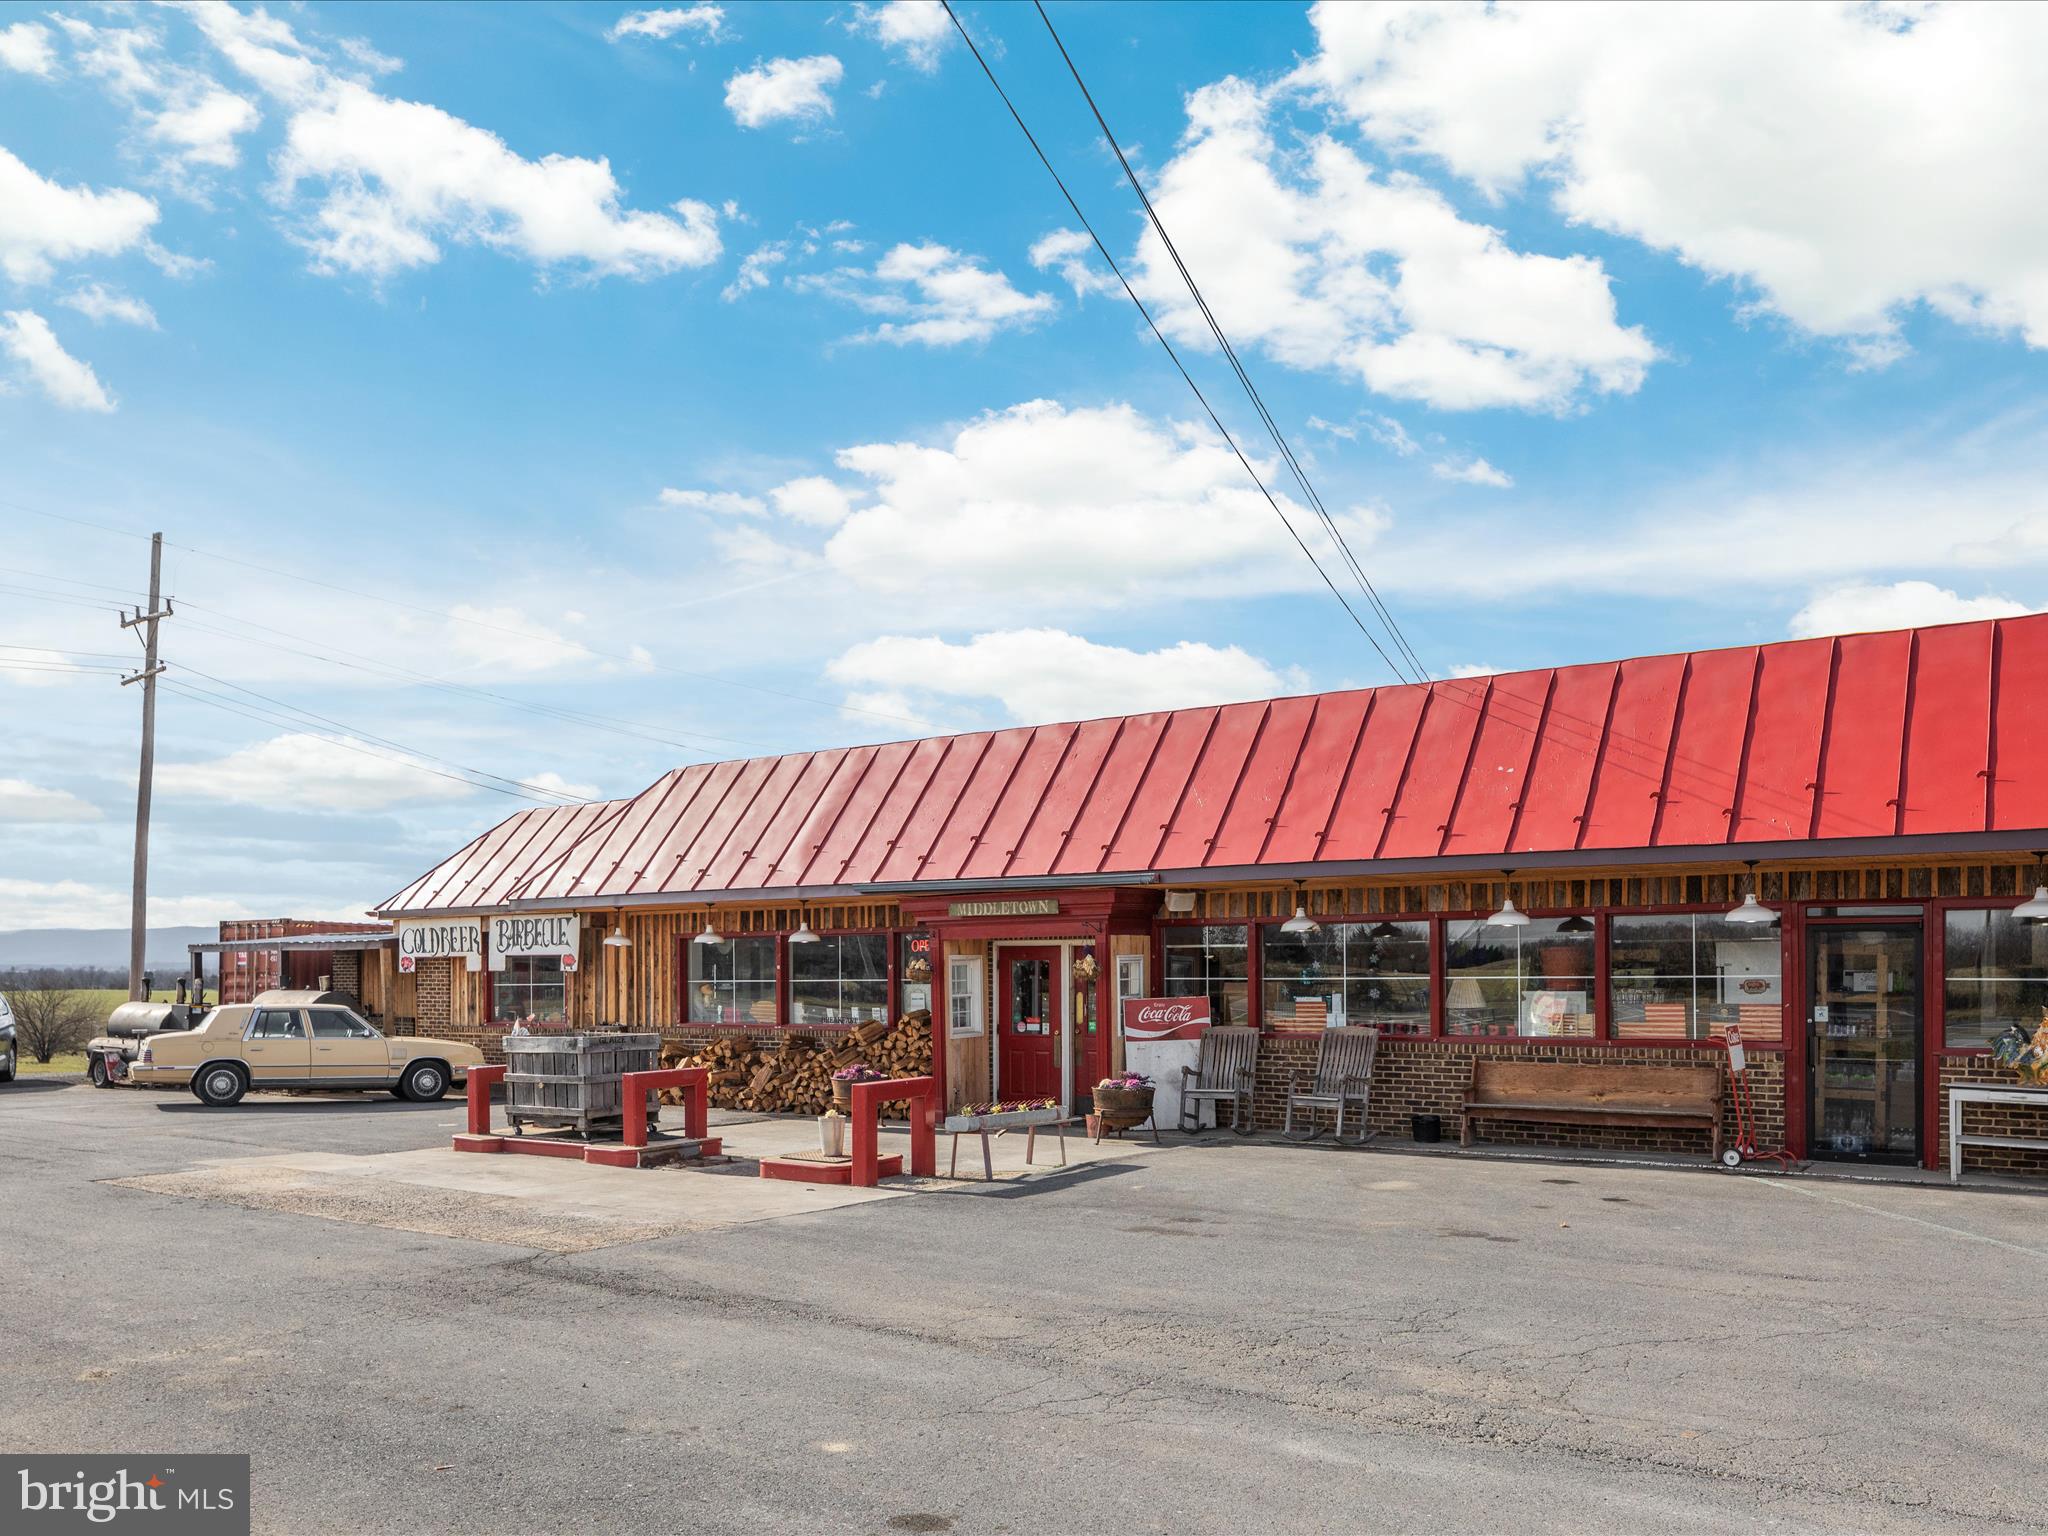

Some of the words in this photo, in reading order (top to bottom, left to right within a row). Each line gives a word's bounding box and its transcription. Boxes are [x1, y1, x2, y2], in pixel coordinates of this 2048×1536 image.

[957, 899, 1049, 917] MIDDLETOWN
[496, 916, 573, 954] BARBECUE
[911, 939, 930, 953] OPE
[1138, 1004, 1193, 1024] Coca-Cola
